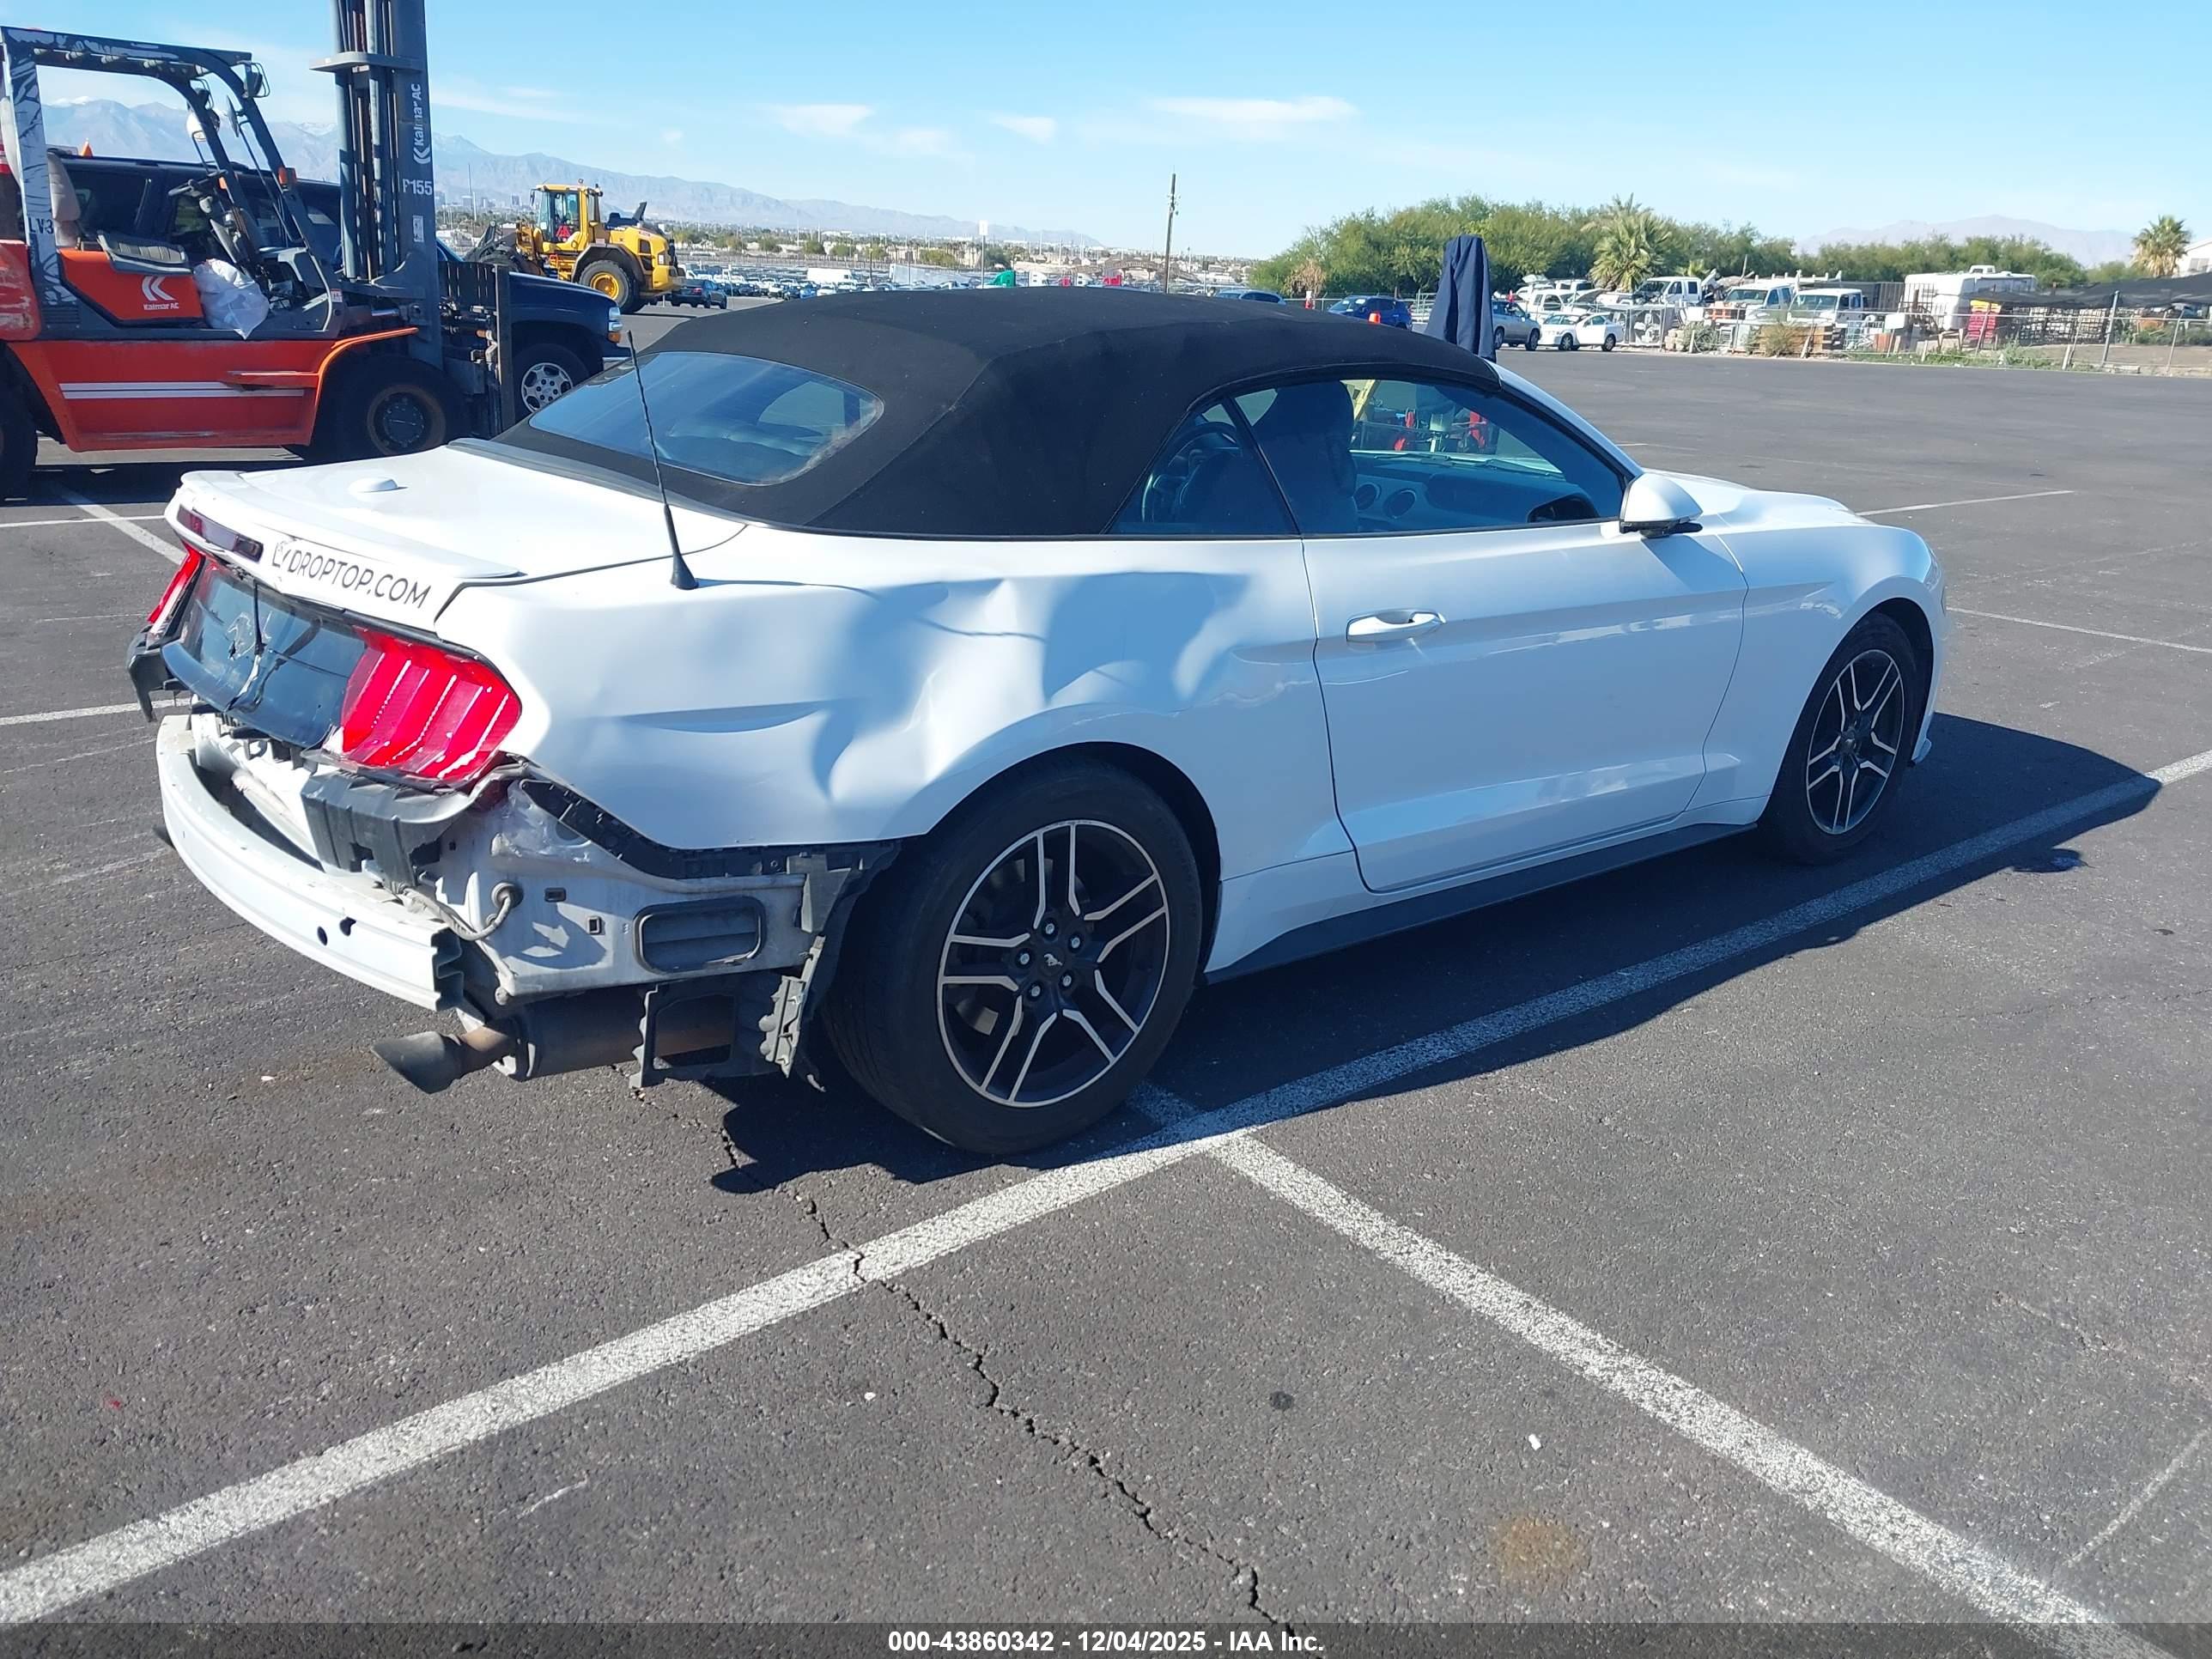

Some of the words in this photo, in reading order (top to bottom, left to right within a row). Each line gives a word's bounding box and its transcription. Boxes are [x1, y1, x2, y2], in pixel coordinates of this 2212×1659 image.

[410, 83, 422, 100] AC
[403, 179, 433, 196] P155
[28, 217, 54, 234] LV3
